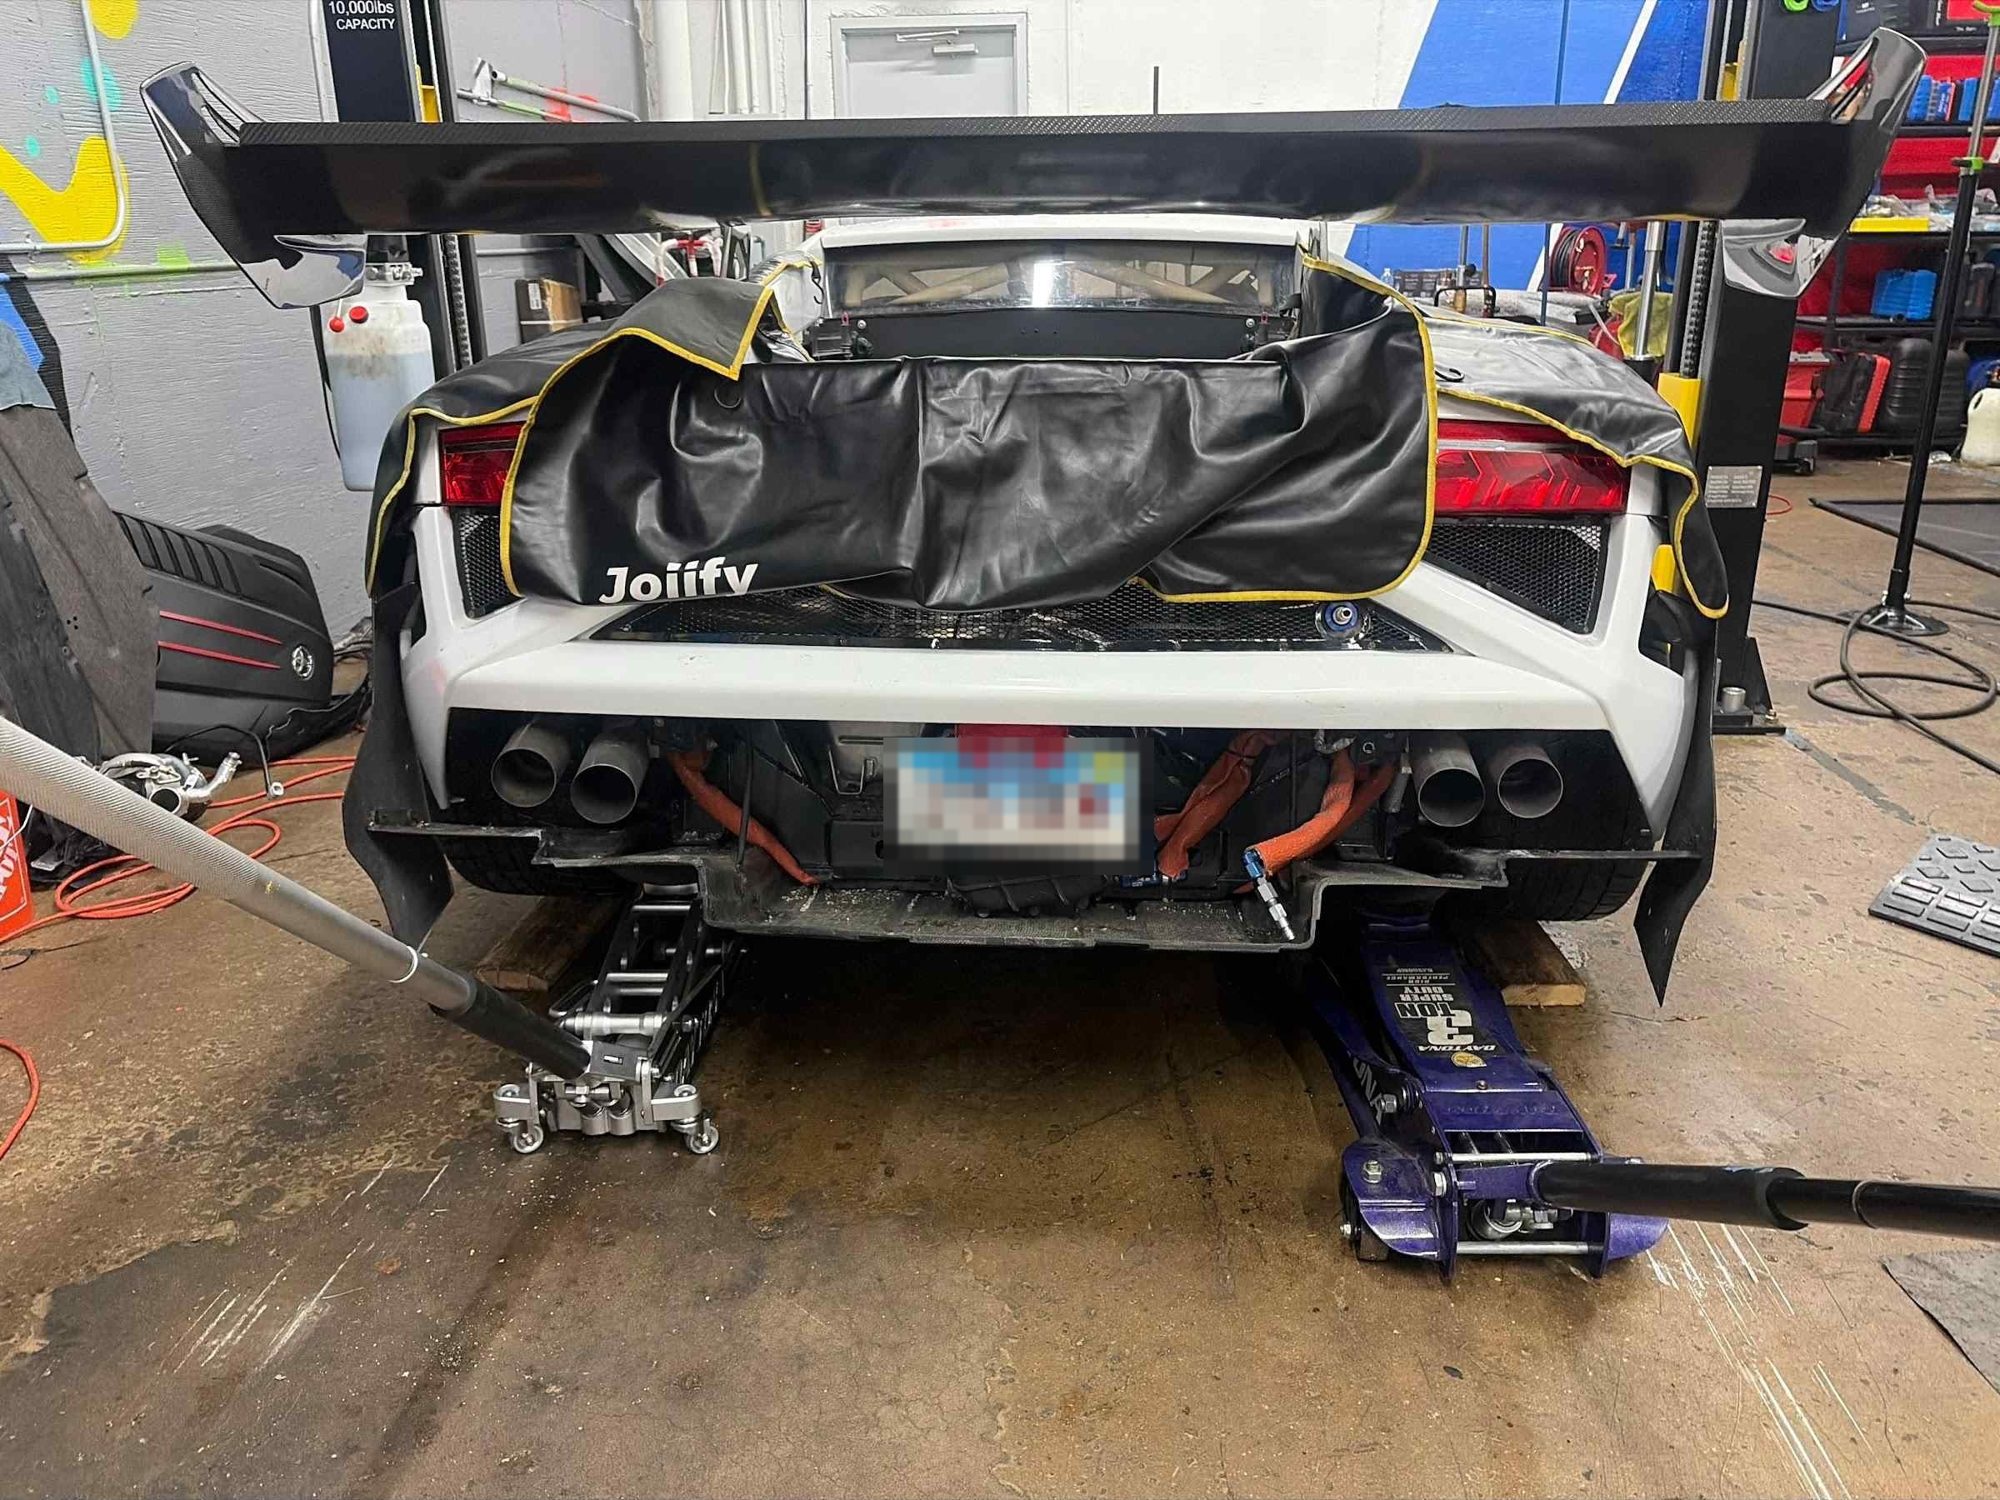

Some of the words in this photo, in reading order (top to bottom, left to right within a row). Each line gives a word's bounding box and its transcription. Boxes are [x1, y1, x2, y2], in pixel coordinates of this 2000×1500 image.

[329, 0, 395, 15] 10,000lbs
[336, 18, 396, 30] CAPACITY
[599, 556, 759, 604] Joiify
[1403, 986, 1444, 994] DUTY
[1400, 993, 1454, 1002] SUPER
[1394, 1001, 1457, 1019] TON
[1426, 1009, 1474, 1046] 3
[1418, 1044, 1497, 1052] DAYTONA
